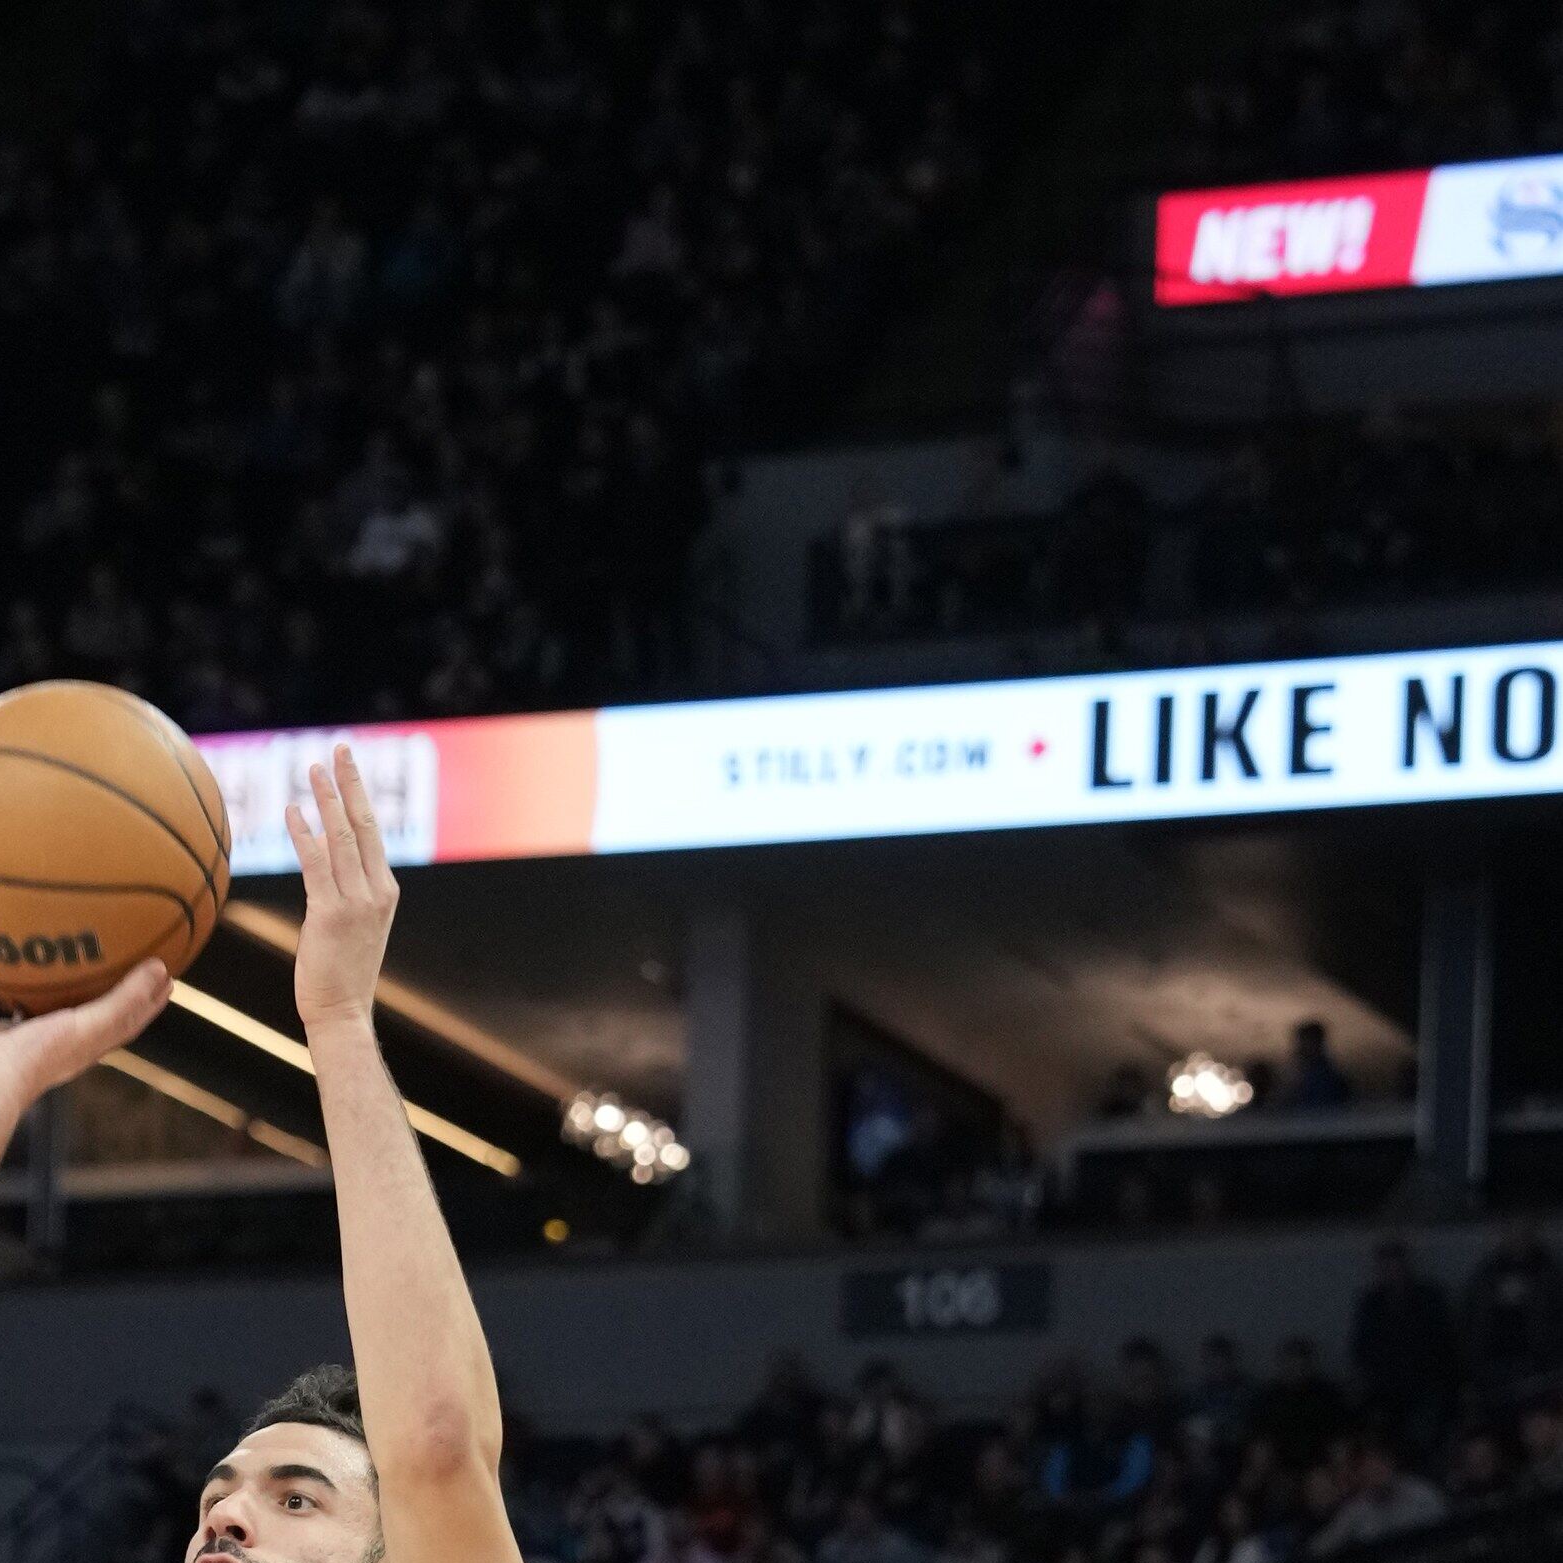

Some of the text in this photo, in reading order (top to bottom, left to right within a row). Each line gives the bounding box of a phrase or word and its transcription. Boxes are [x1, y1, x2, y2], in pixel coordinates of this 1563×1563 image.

[1189, 195, 1375, 284] NEW!
[722, 738, 994, 788] STILLY.COM
[1089, 664, 1557, 791] LIKE NO
